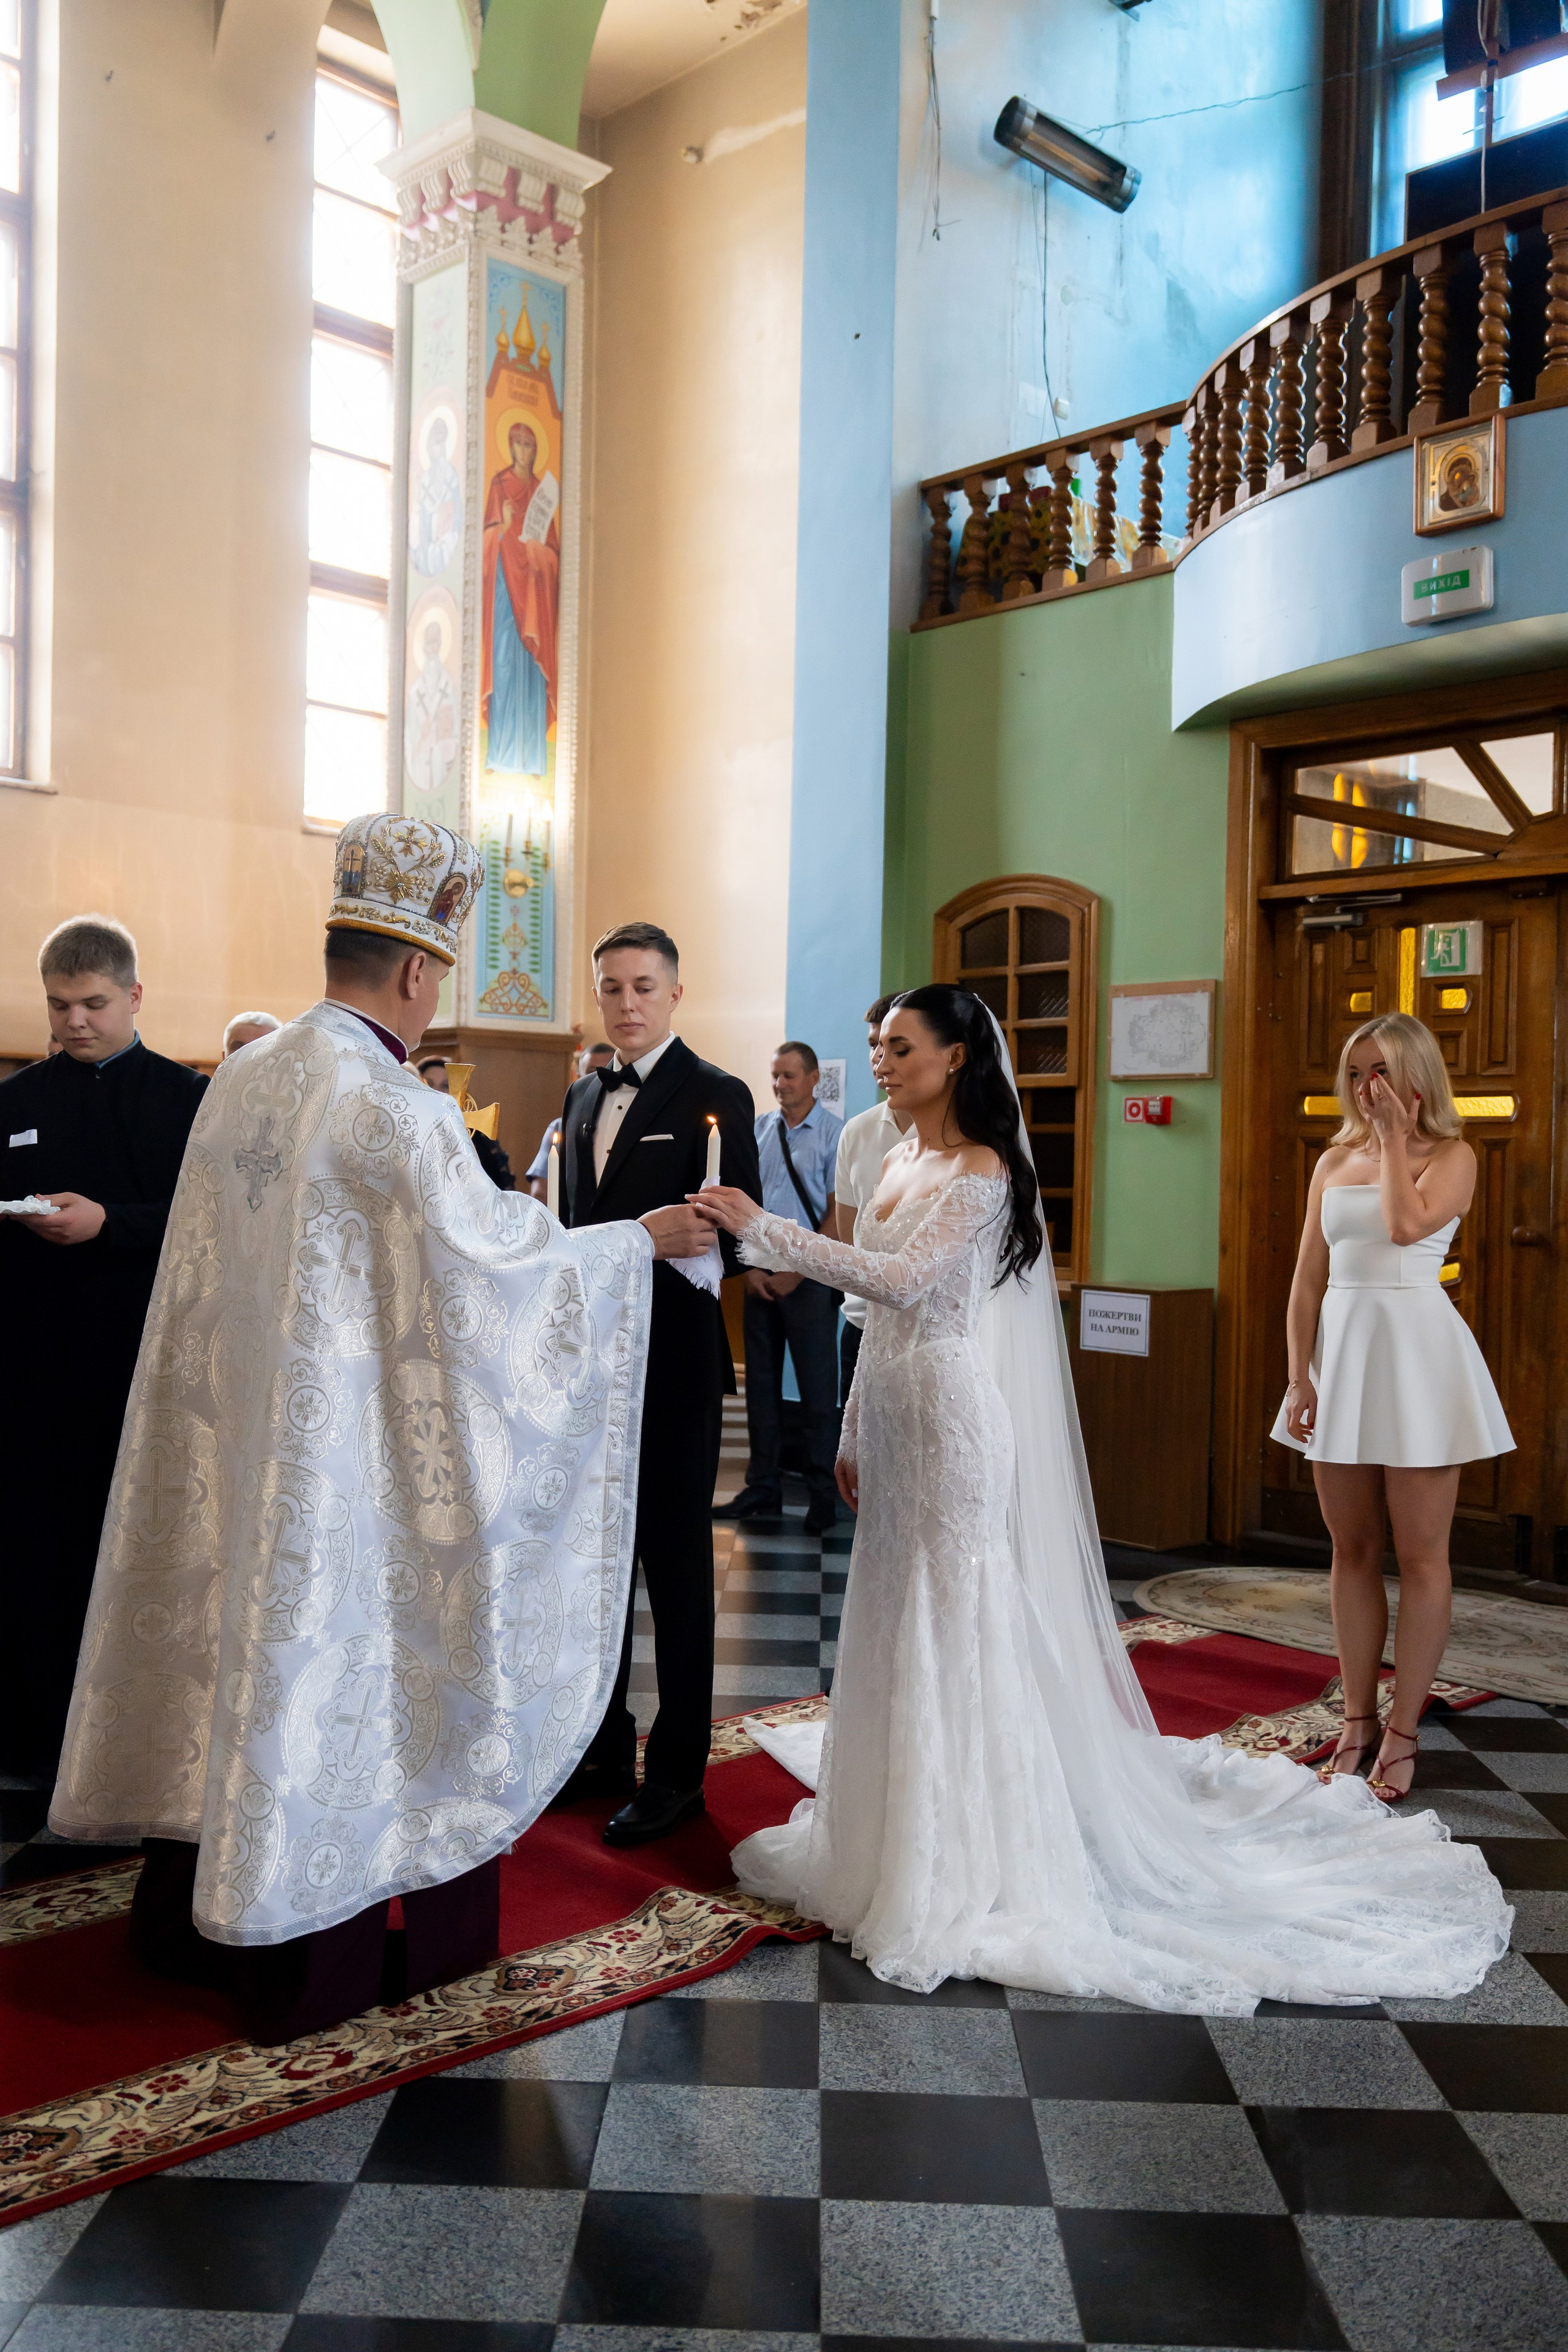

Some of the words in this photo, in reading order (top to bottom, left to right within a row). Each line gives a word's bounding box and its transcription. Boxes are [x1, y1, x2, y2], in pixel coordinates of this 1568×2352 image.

[1421, 575, 1461, 592] ВИХІД
[1088, 1309, 1142, 1322] ПОЖЕРТВИ
[1091, 1323, 1104, 1332] НА
[1105, 1325, 1139, 1335] АРМІЮ
